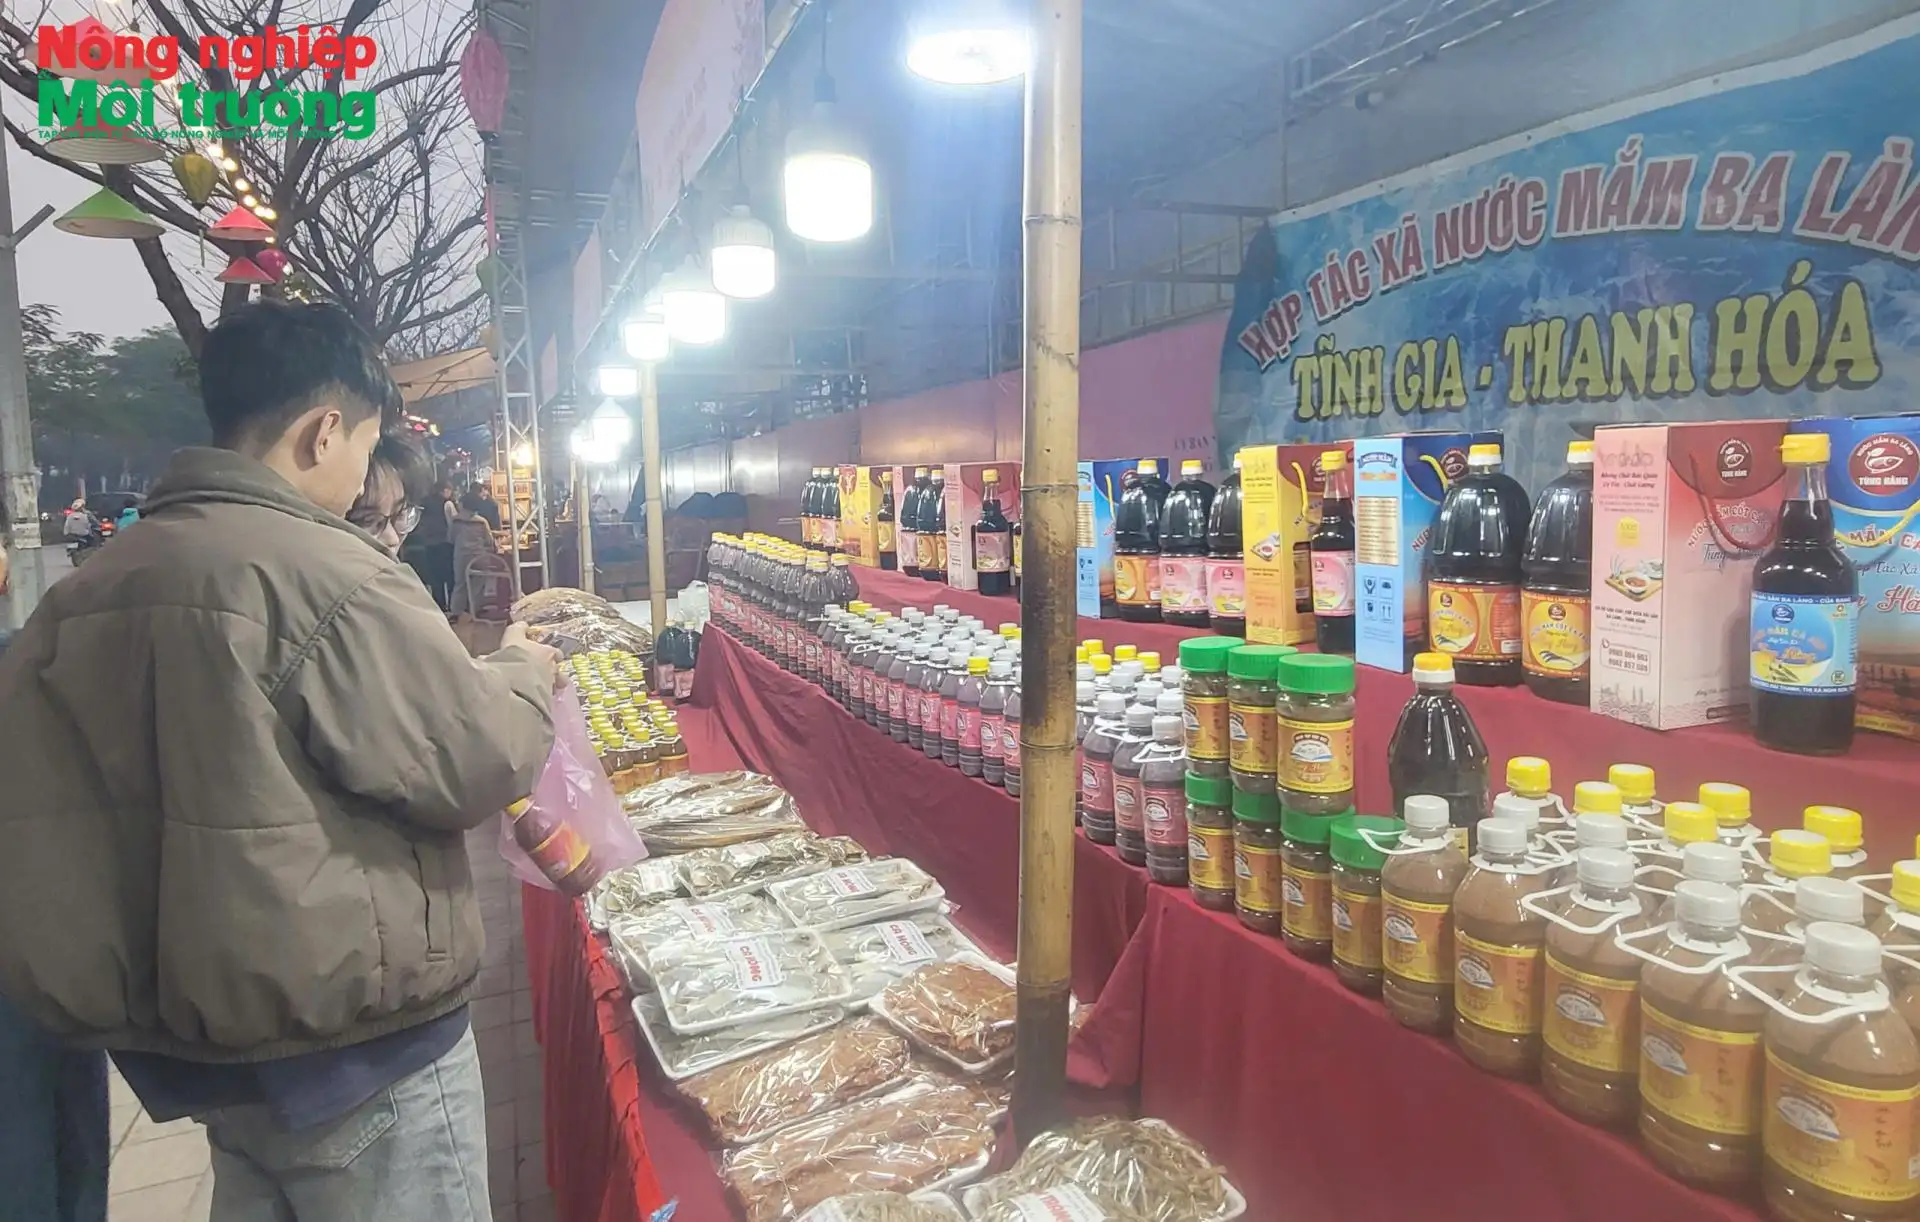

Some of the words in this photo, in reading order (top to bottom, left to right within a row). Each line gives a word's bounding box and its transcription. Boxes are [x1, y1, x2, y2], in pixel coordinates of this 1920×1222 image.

[1239, 292, 1303, 371] HỢP
[1307, 250, 1372, 322] TÁC
[1376, 228, 1426, 291] XÃ
[1433, 174, 1547, 268] NƯỚC
[1553, 134, 1697, 237] MẮM
[1696, 151, 1795, 231] BA
[1293, 334, 1385, 418] TĨNH
[1395, 335, 1467, 411] GIA
[1480, 366, 1492, 385] -
[1504, 302, 1695, 401] THANH
[1711, 260, 1880, 390] HÓA
